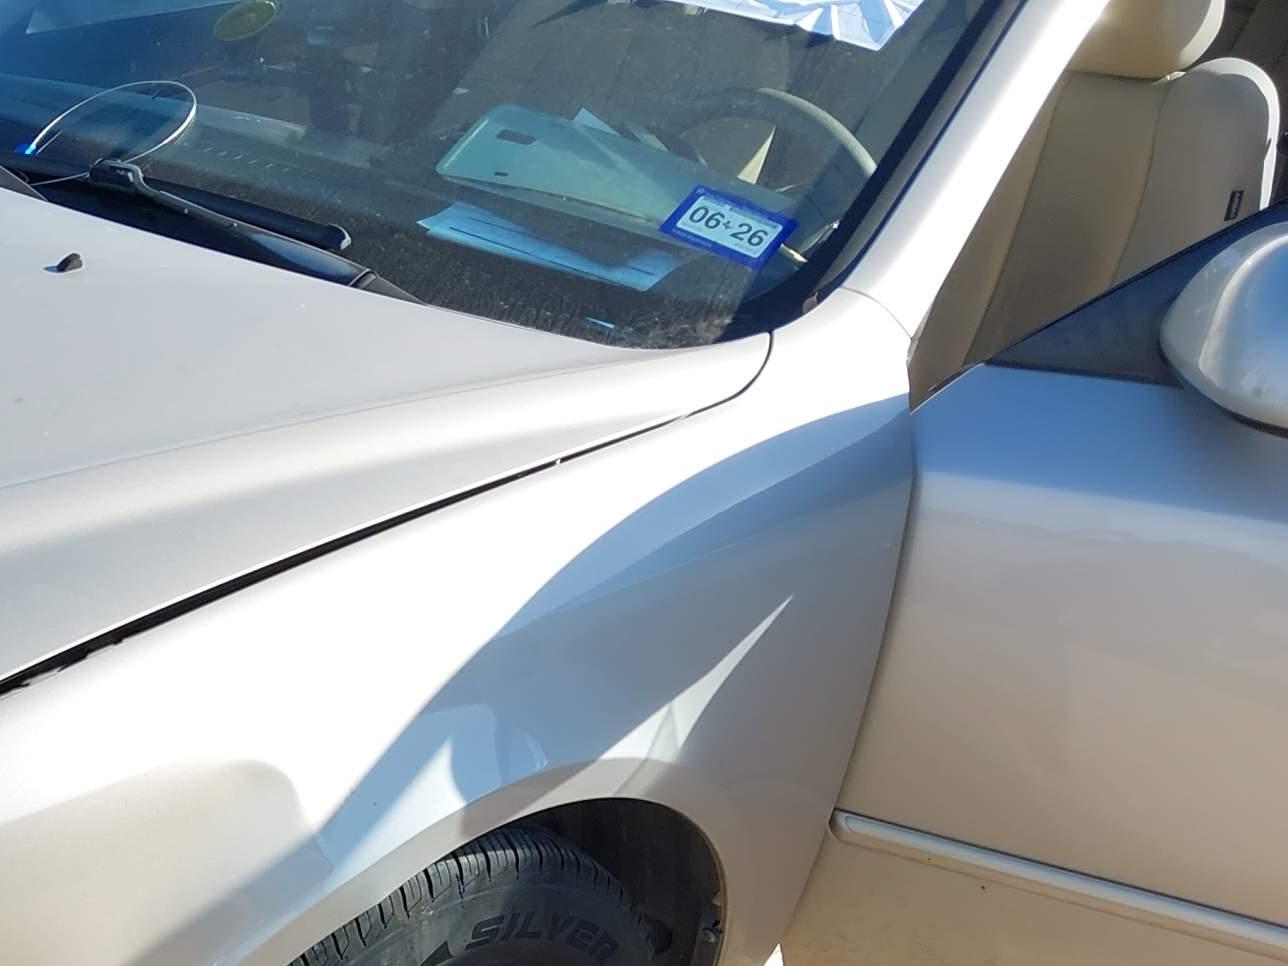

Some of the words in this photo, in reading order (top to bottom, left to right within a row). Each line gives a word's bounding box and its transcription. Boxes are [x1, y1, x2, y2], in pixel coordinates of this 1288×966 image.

[689, 206, 724, 230] 06
[730, 222, 768, 247] 26
[465, 911, 619, 966] SILVER
